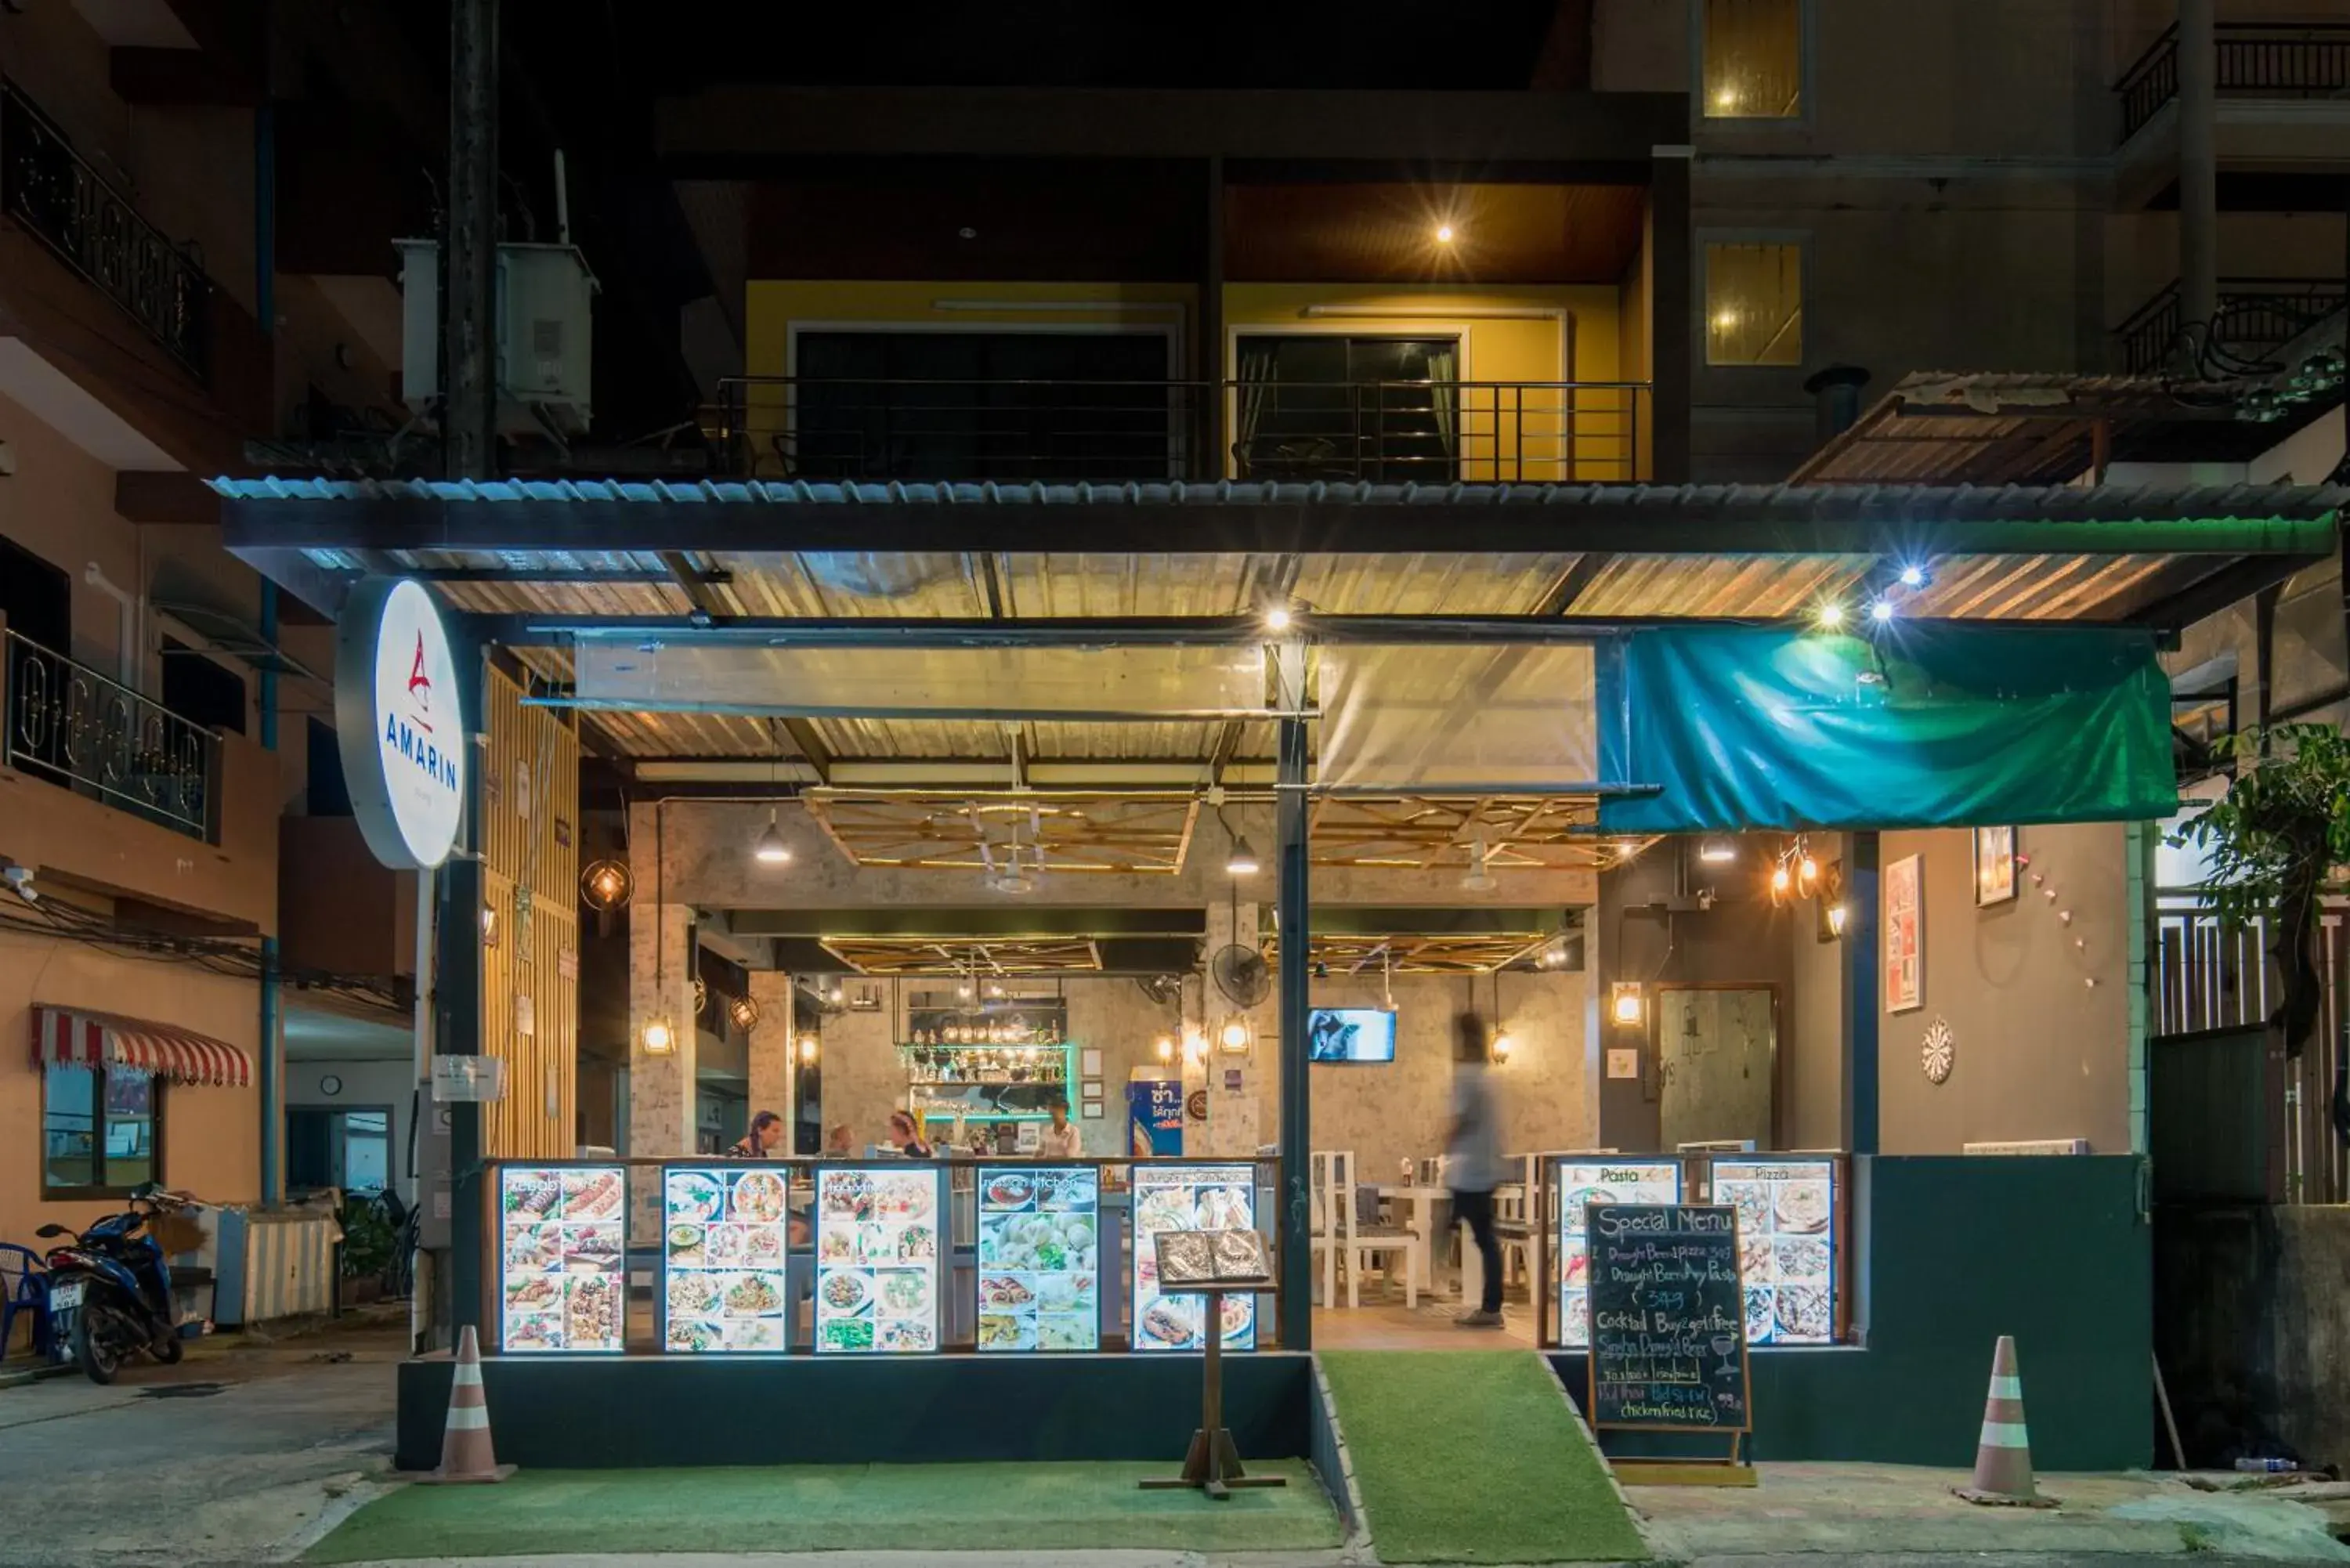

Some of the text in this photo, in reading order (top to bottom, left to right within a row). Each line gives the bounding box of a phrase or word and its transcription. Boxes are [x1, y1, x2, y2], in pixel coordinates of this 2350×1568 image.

[386, 713, 456, 792] AMARIN
[1600, 1168, 1640, 1183] Pasta
[1755, 1166, 1789, 1180] Pizza
[1599, 1209, 1733, 1245] Special Menu
[1596, 1309, 1647, 1331] Cocktail
